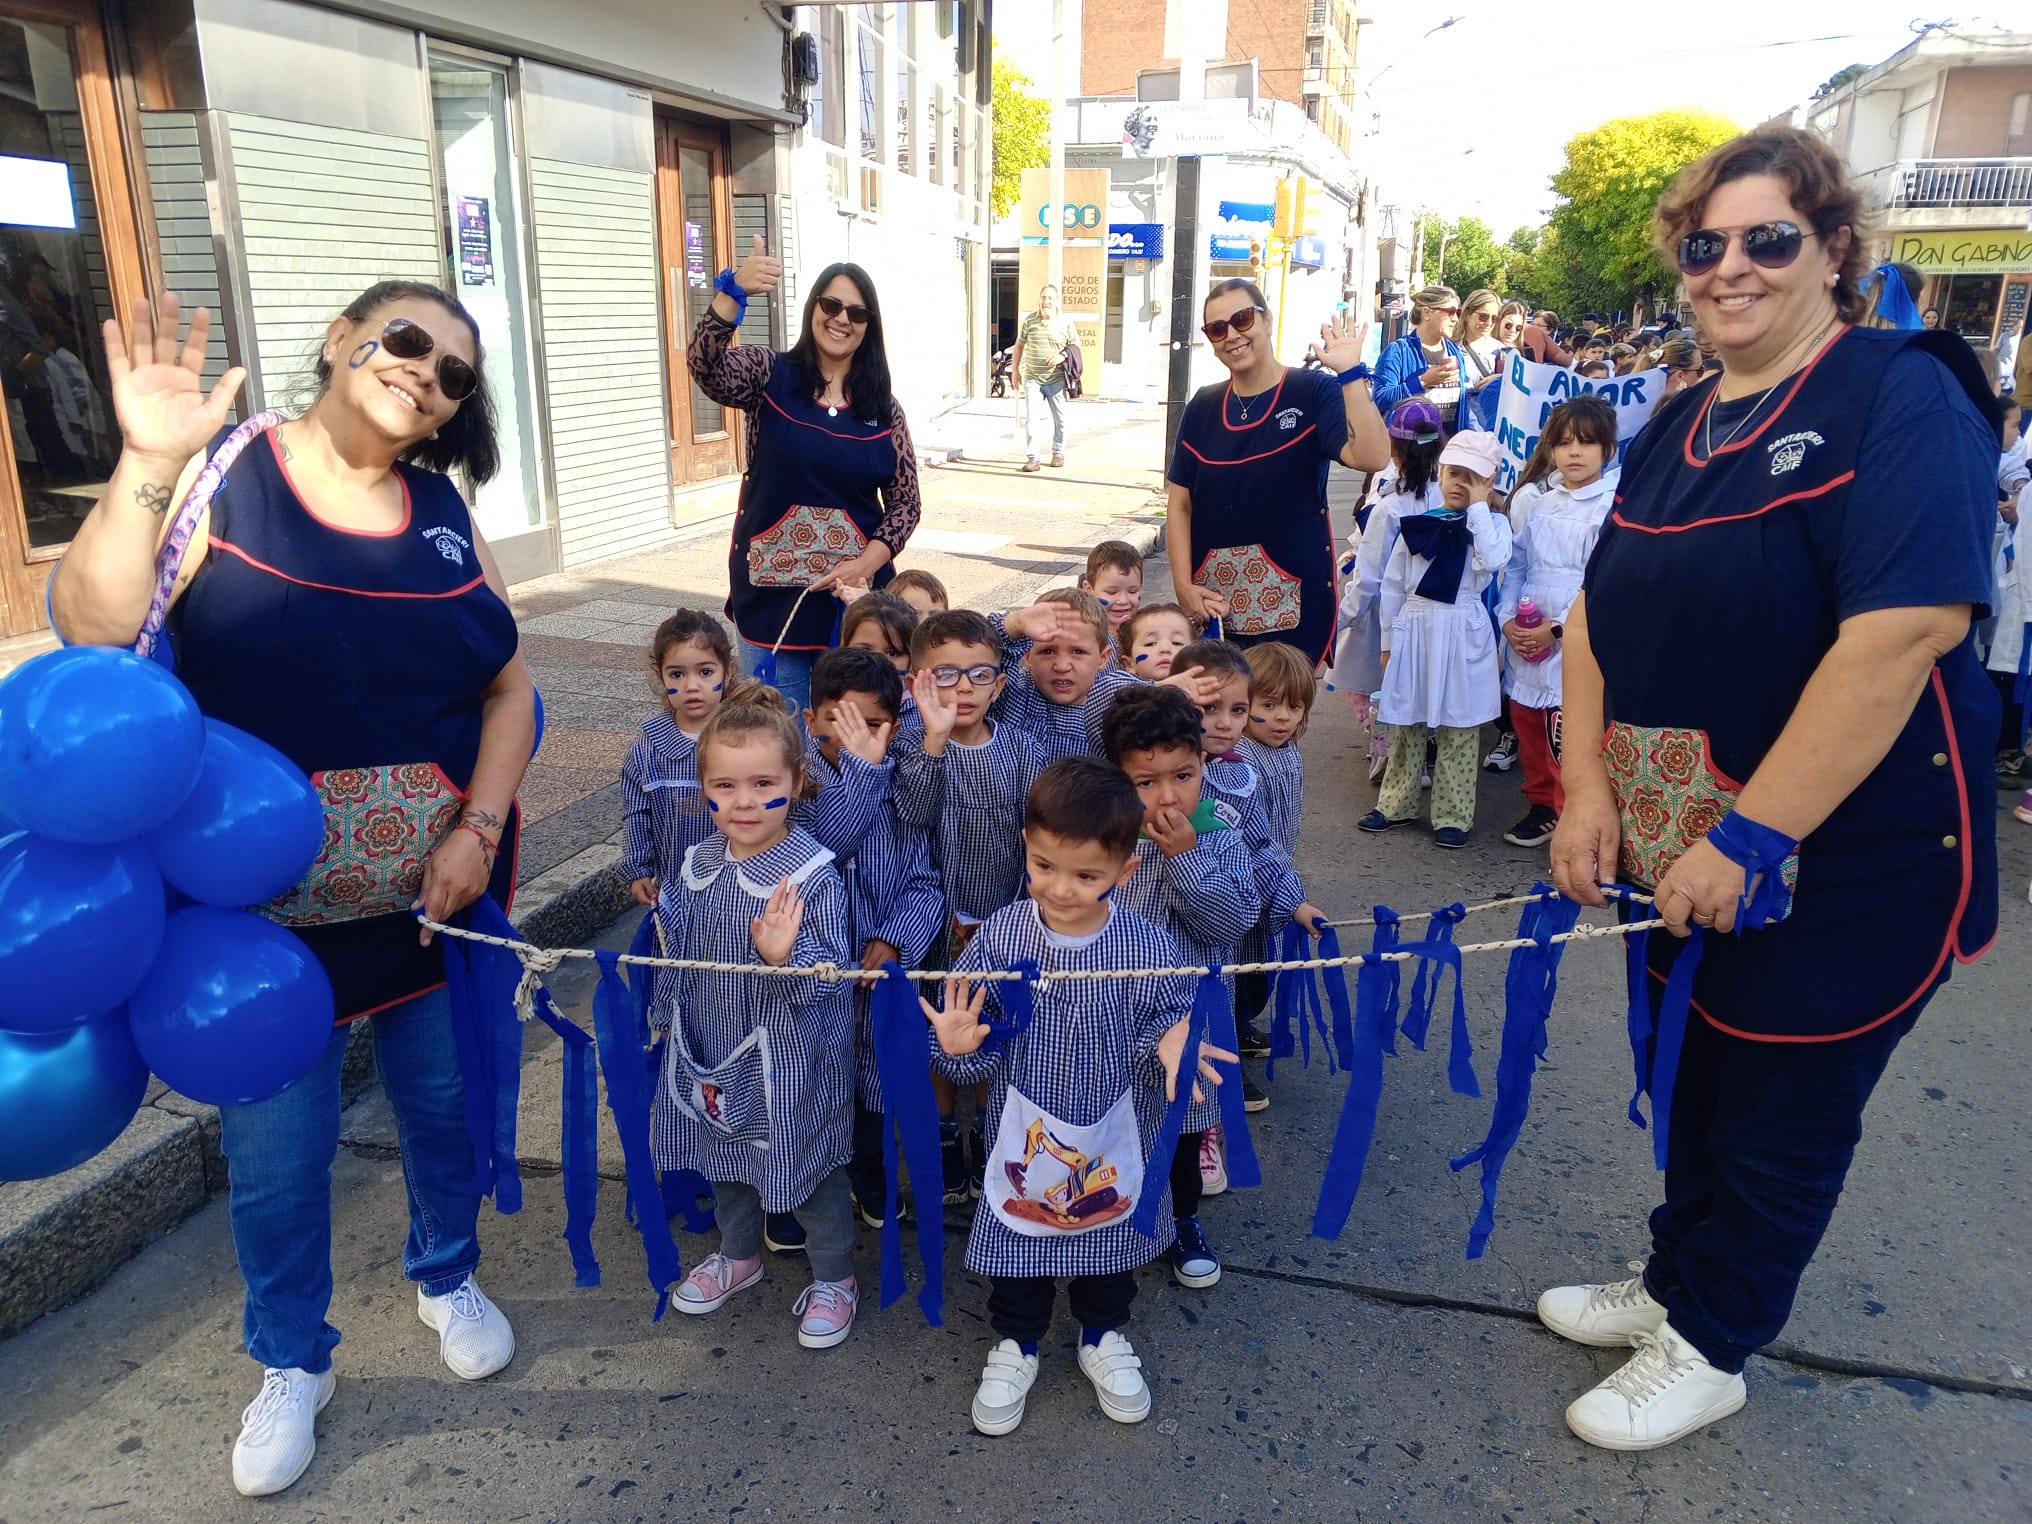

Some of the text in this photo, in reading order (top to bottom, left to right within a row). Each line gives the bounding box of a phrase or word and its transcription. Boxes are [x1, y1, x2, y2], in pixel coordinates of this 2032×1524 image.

[1063, 276, 1100, 285] NCO DE
[1062, 286, 1100, 295] EGUROS
[1063, 296, 1099, 305] ESTADO
[1548, 370, 1647, 407] AMOR
[1770, 460, 1802, 476] CAIF
